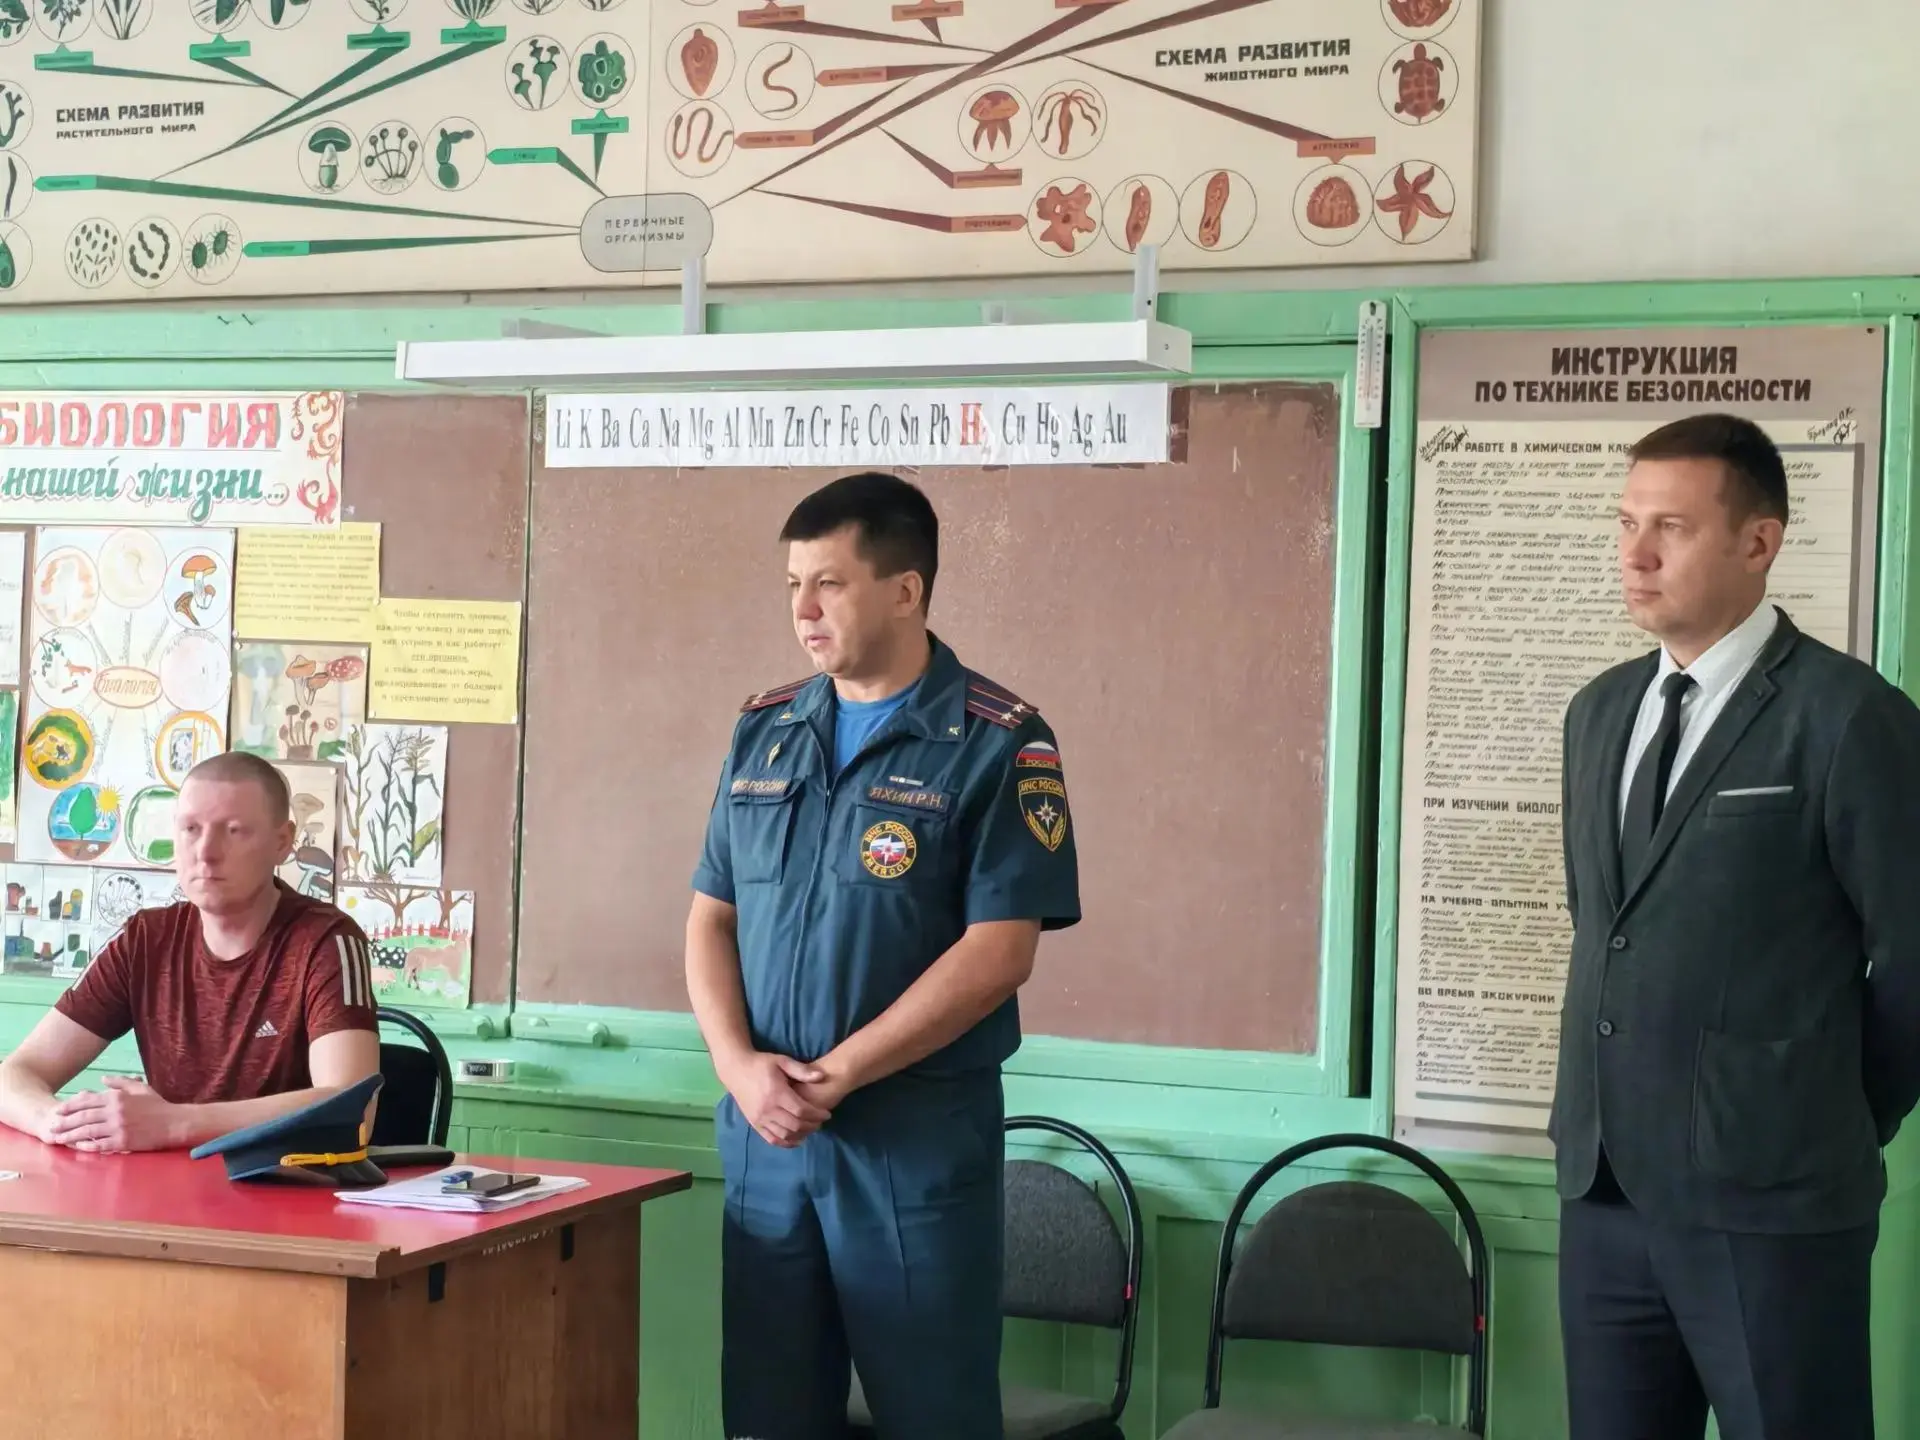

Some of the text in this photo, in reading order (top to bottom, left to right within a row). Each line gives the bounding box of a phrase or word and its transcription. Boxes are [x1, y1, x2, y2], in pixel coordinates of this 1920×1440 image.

[1155, 38, 1351, 67] СХЕМА РАЗВИТИЯ
[1204, 64, 1349, 82] ЖИВОТНОГО МИРА
[56, 101, 204, 123] СХЕМА РАЗВИТИЯ
[56, 123, 196, 139] РАСТИТЕЛЬНОГО МИРА
[604, 216, 684, 229] ПЕРВИЧНЫЕ
[604, 231, 684, 243] ОРГАНИЗМЫ
[1552, 346, 1737, 376] ИНСТРУКЦИЯ
[1475, 379, 1812, 403] ПО ТЕХНИКЕ БЕЗОПАСНОСТИ
[0, 401, 281, 448] БИОЛОГИЯ
[556, 408, 571, 448] Li
[580, 408, 592, 448] K
[601, 408, 620, 448] Ba
[629, 407, 650, 448] Ca
[659, 407, 680, 448] Na
[689, 407, 714, 460] Mg
[722, 406, 740, 448] Al
[749, 406, 774, 448] Mn
[784, 406, 805, 447] Zn
[811, 405, 831, 447] Cr
[840, 404, 860, 446] Fe
[868, 403, 890, 446] Co
[899, 403, 919, 445] Sn
[929, 402, 950, 445] Pb
[1002, 402, 1025, 445] Cu
[1036, 401, 1060, 457] Hg
[1069, 402, 1093, 456] Ag
[1102, 400, 1127, 444] Au
[1465, 441, 1504, 453] РАБОТЕ
[1510, 442, 1518, 453] В
[1523, 442, 1602, 454] ХИМИЧЕСКОМ
[3, 456, 119, 499] нашей
[867, 786, 915, 804] ЯХИН
[1020, 780, 1065, 795] МЧС РОССИИ
[1423, 797, 1445, 808] ПРИ
[1452, 799, 1509, 811] ИЗУЧЕНИИ
[1421, 895, 1436, 904] НА
[1417, 987, 1556, 1004] ВО ВРЕМЯ ЭКСКУРСИИ
